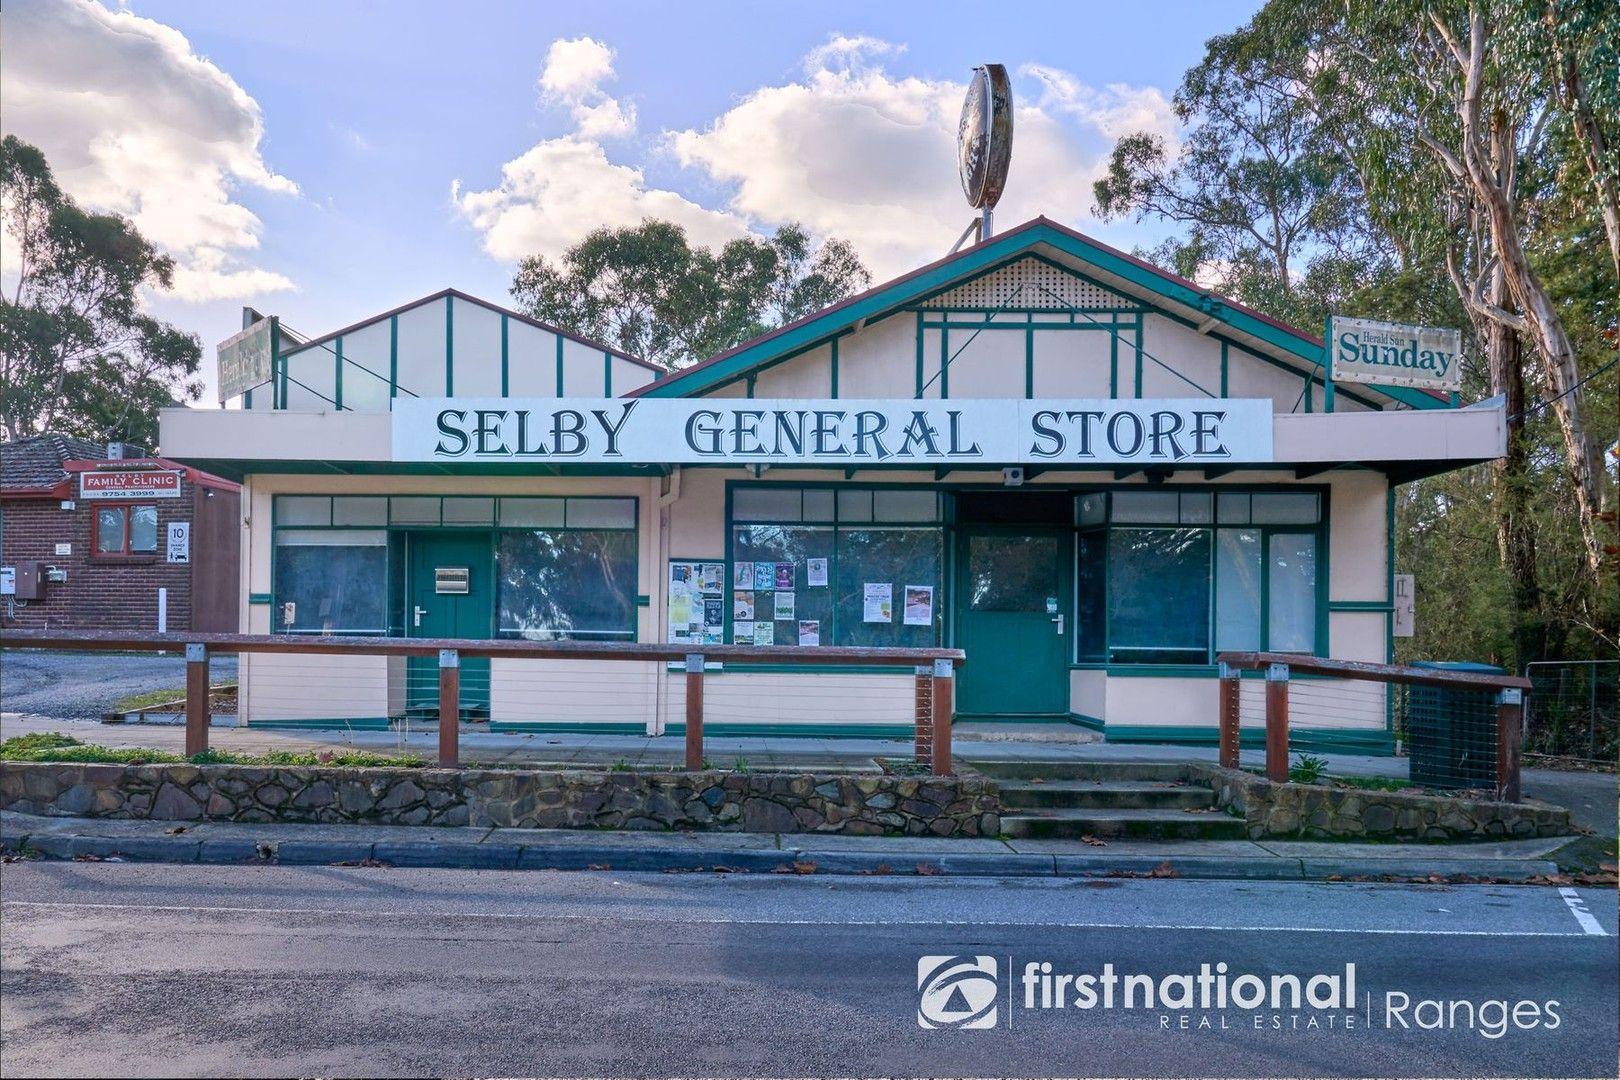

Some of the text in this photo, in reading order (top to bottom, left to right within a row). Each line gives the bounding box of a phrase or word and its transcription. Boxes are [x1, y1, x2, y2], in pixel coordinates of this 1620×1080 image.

[1363, 331, 1405, 346] Herald Sun
[1339, 332, 1454, 377] Sunday
[434, 399, 1231, 462] SELBY GENERAL STORE
[87, 476, 174, 486] FAMILY CLINIC
[173, 528, 184, 538] 10
